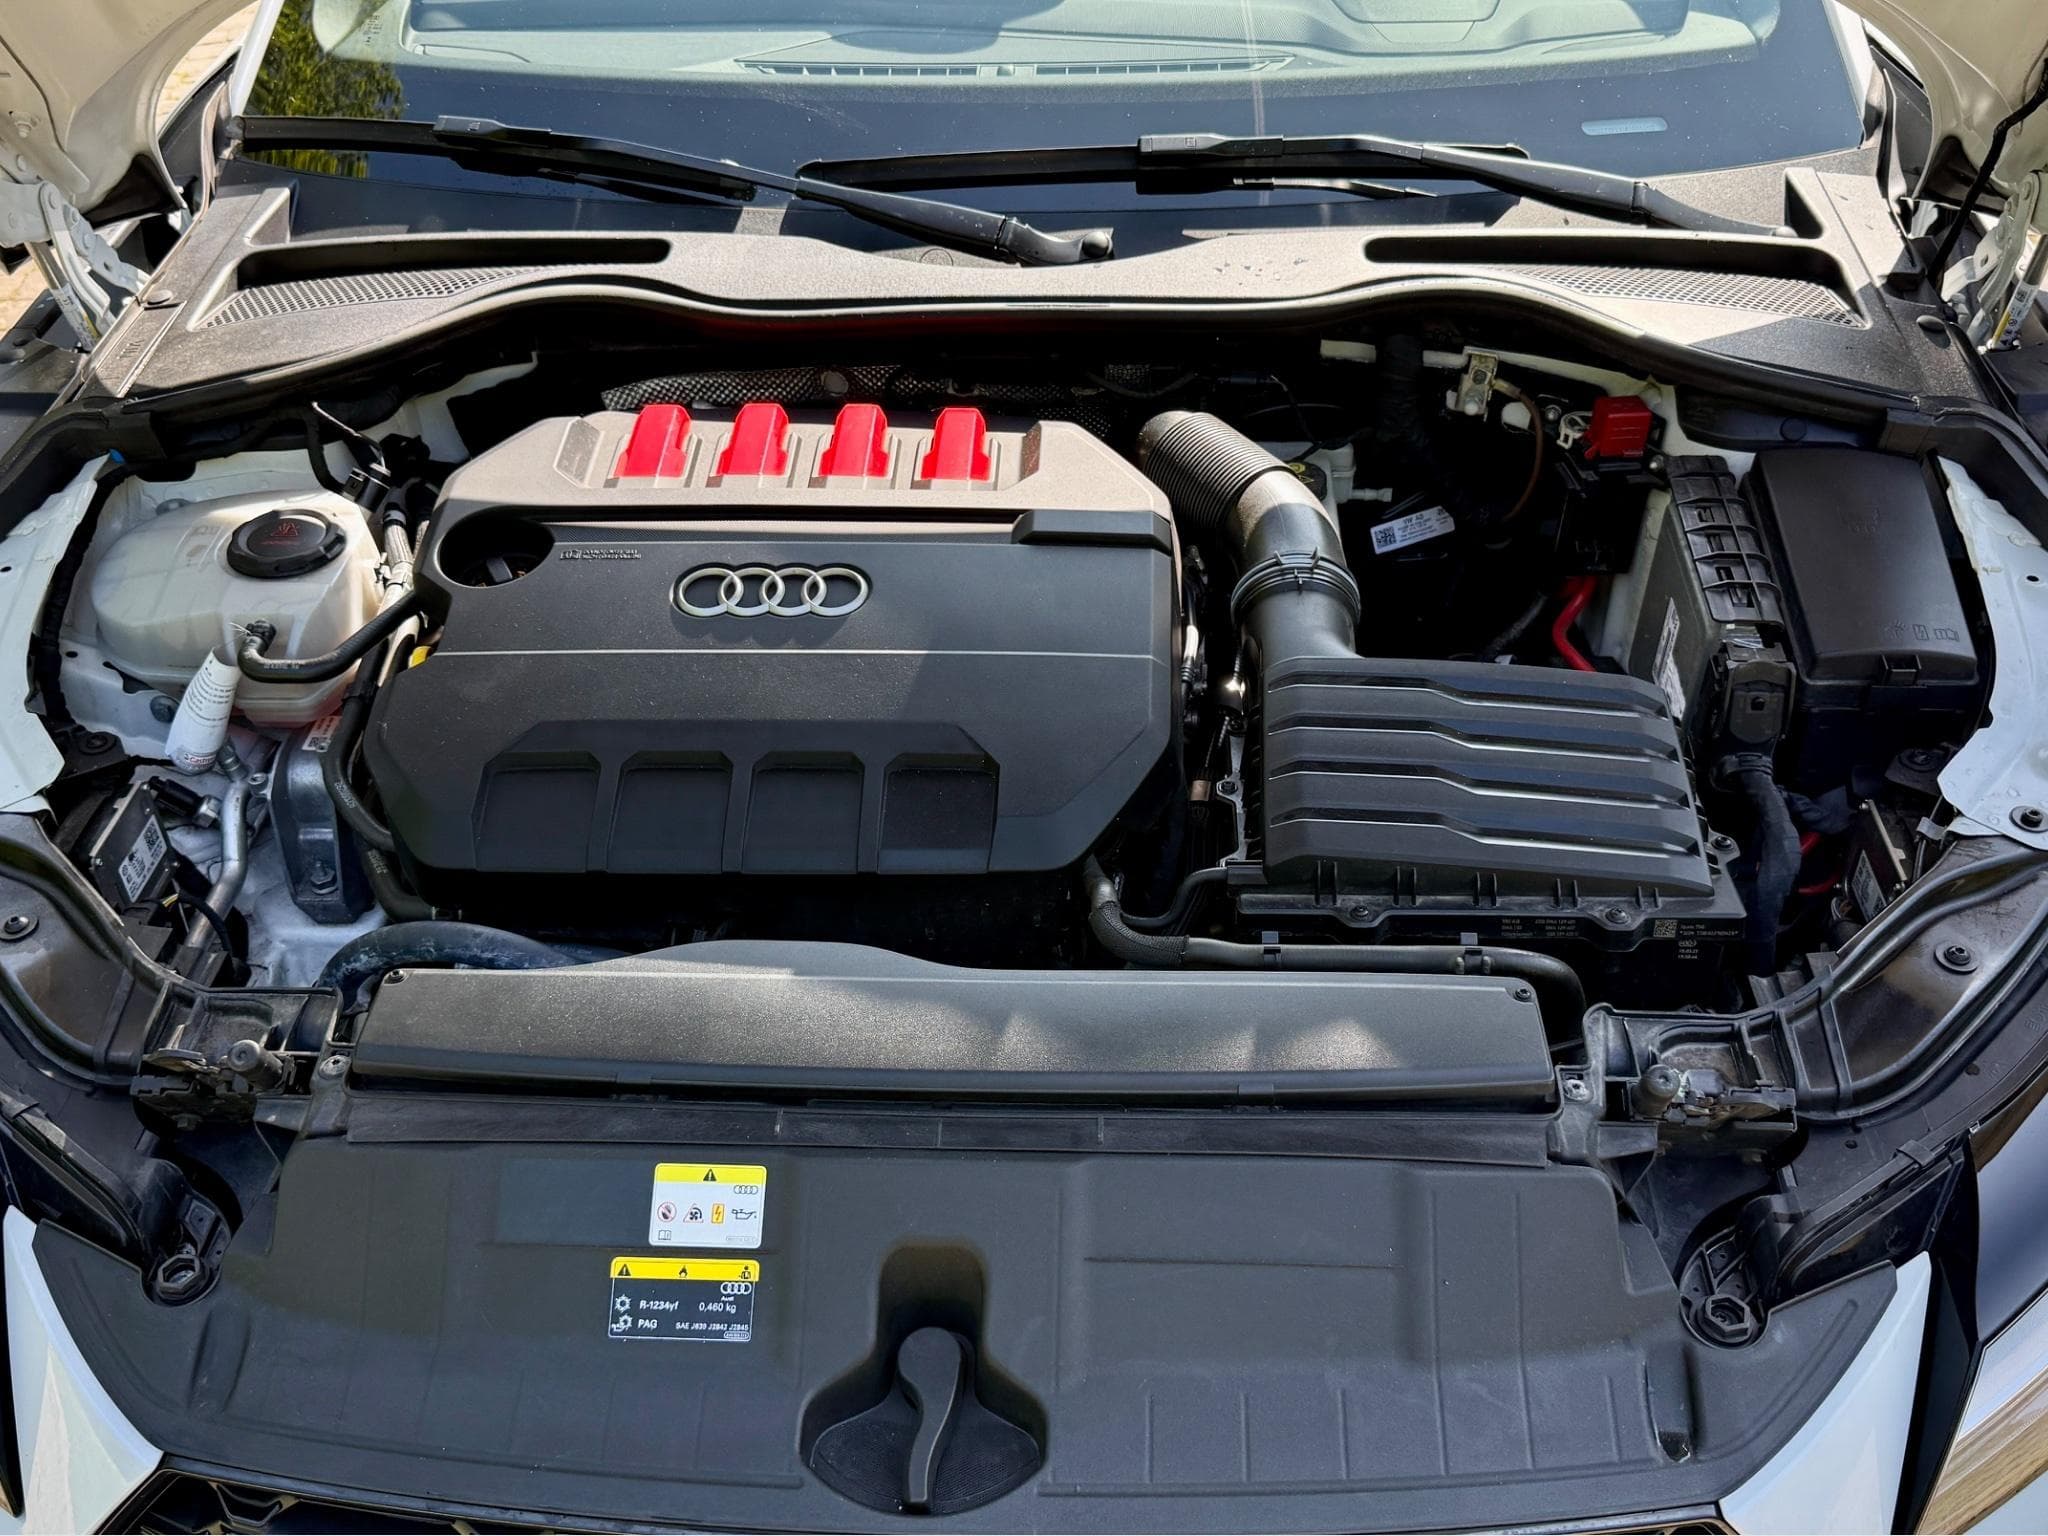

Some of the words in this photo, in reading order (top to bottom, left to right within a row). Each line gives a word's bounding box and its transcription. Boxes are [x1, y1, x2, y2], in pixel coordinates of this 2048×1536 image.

[639, 1300, 679, 1312] R-1234yf
[699, 1302, 724, 1313] 0,460
[726, 1303, 737, 1314] kg
[638, 1319, 658, 1330] PAG
[676, 1322, 690, 1330] SAE
